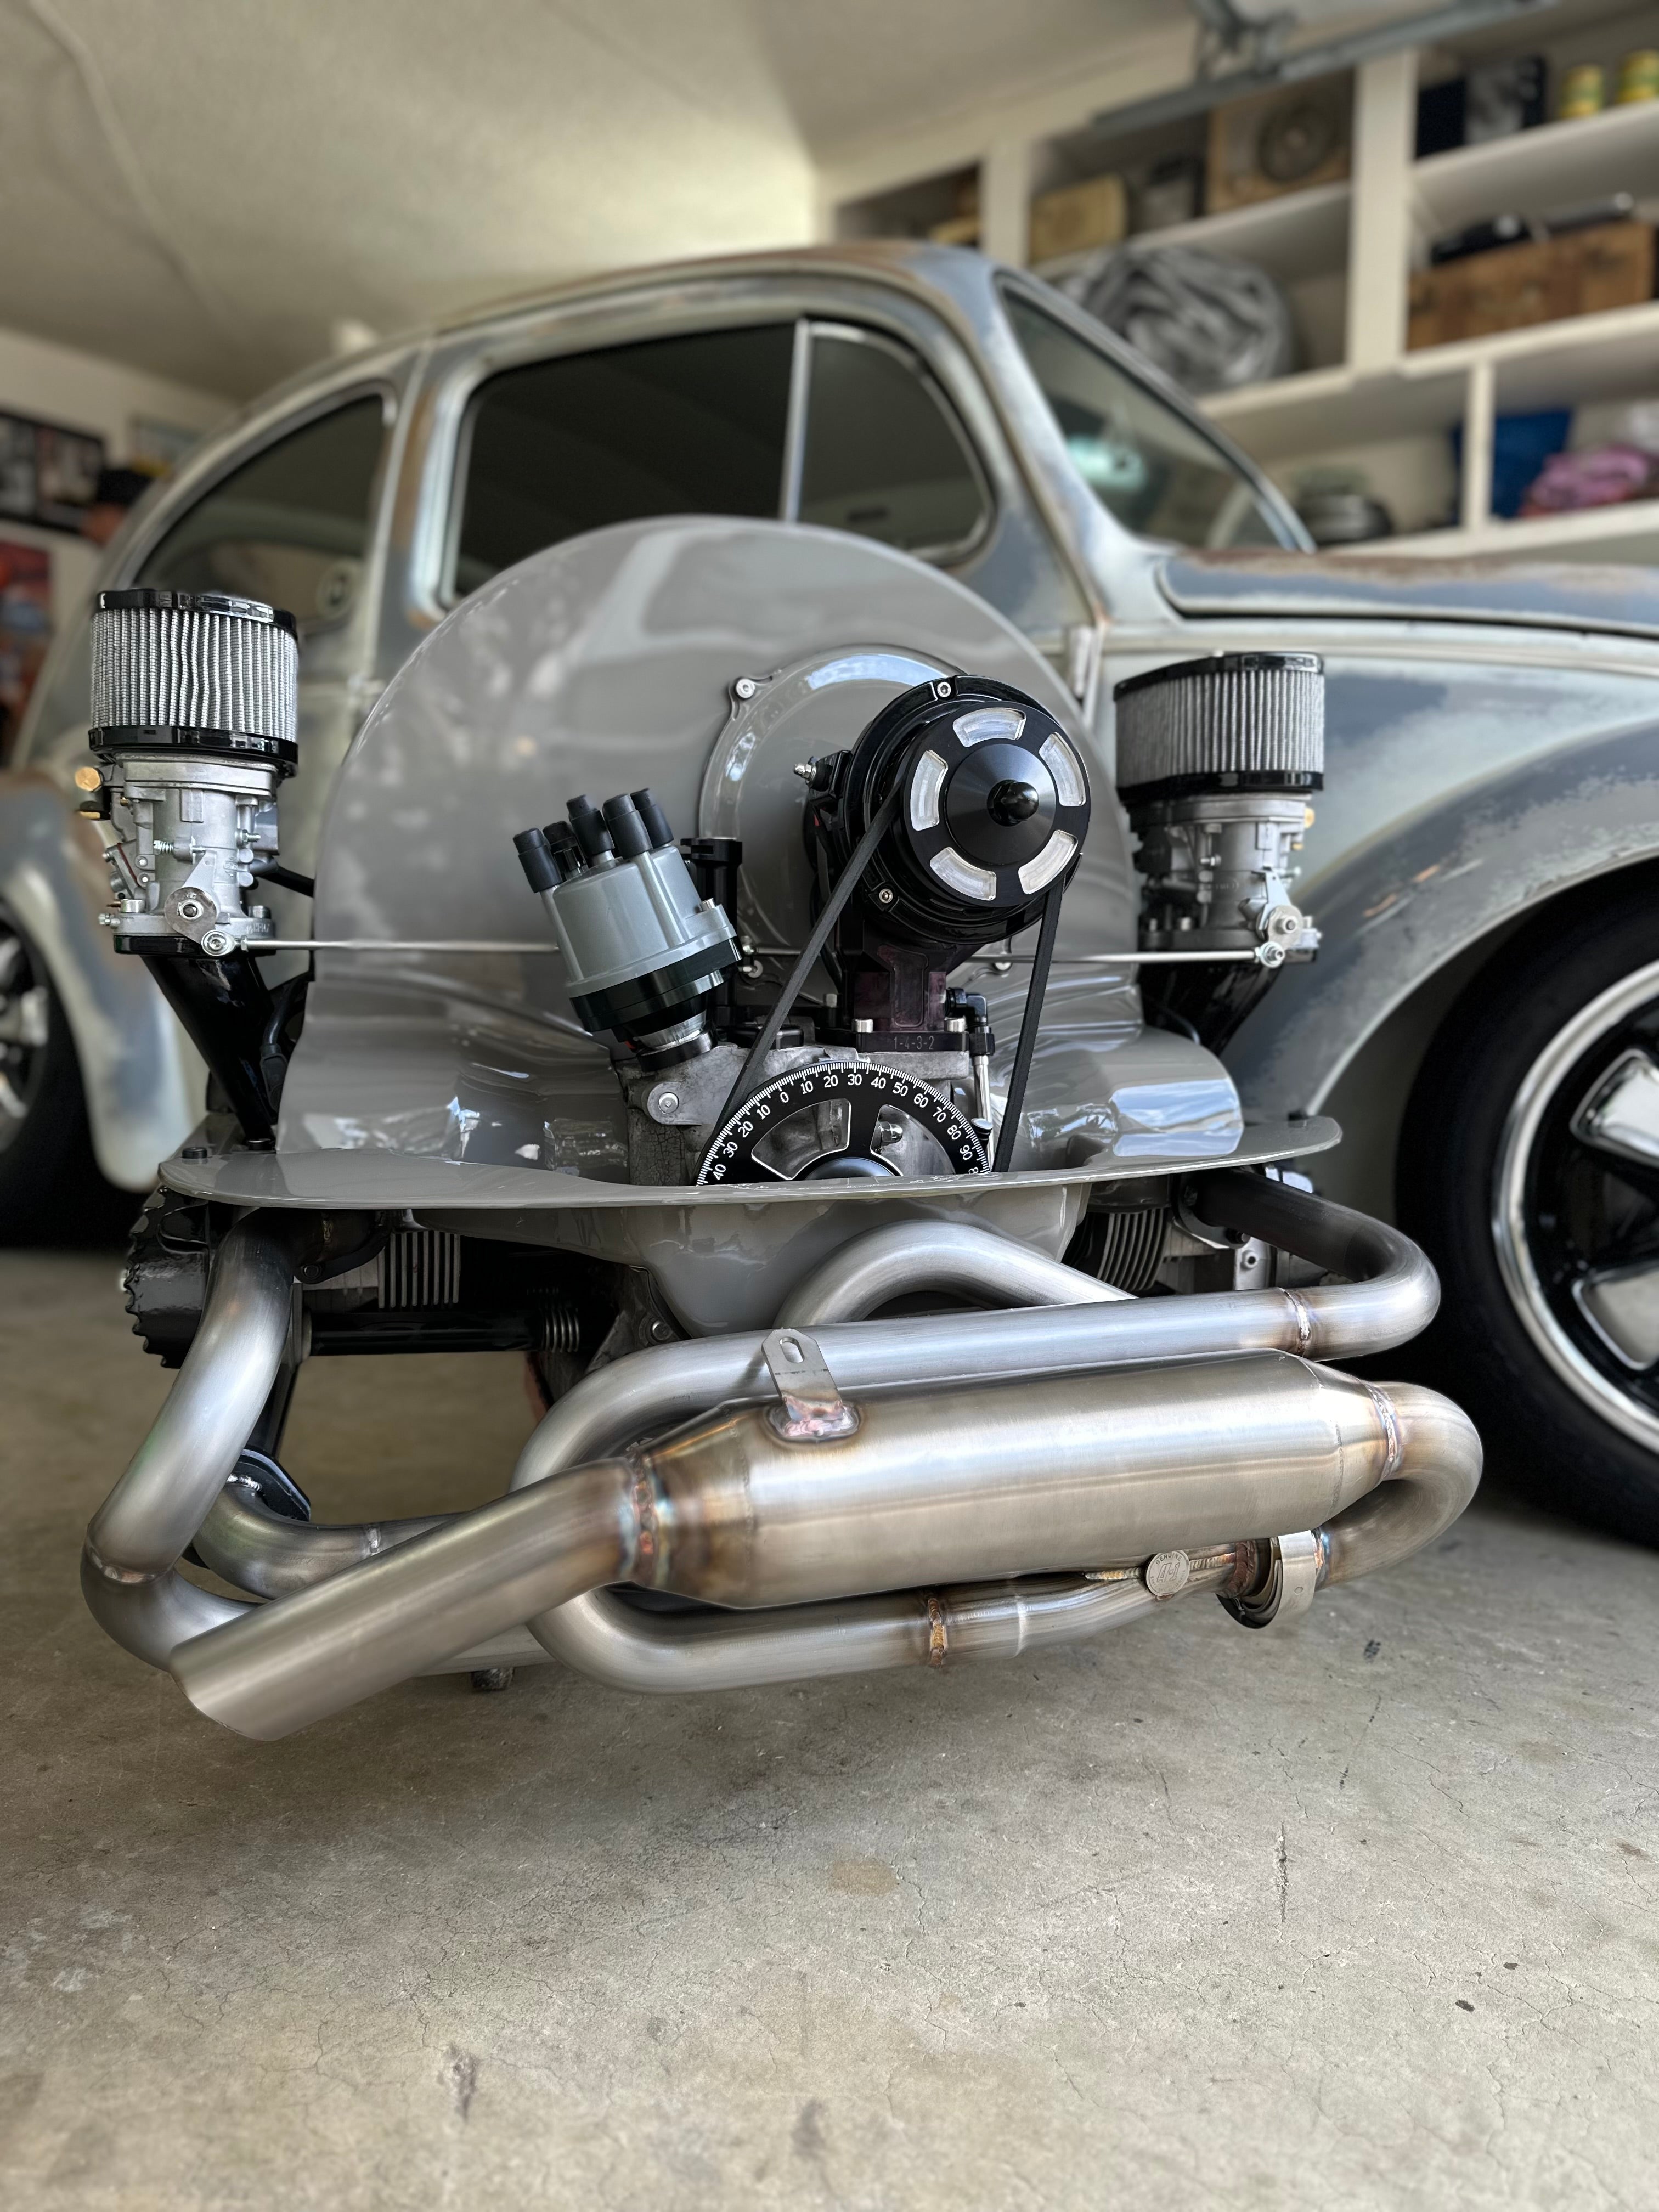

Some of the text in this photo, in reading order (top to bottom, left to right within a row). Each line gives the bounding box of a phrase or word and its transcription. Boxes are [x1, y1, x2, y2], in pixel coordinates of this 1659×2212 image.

[893, 1035, 934, 1050] 1-4-3-2
[713, 1074, 979, 1180] 40 30 20 10 0 10 20 30 40 50 60 70 80 90 8
[1155, 1553, 1182, 1565] GENUINE
[1156, 1562, 1181, 1583] A-1
